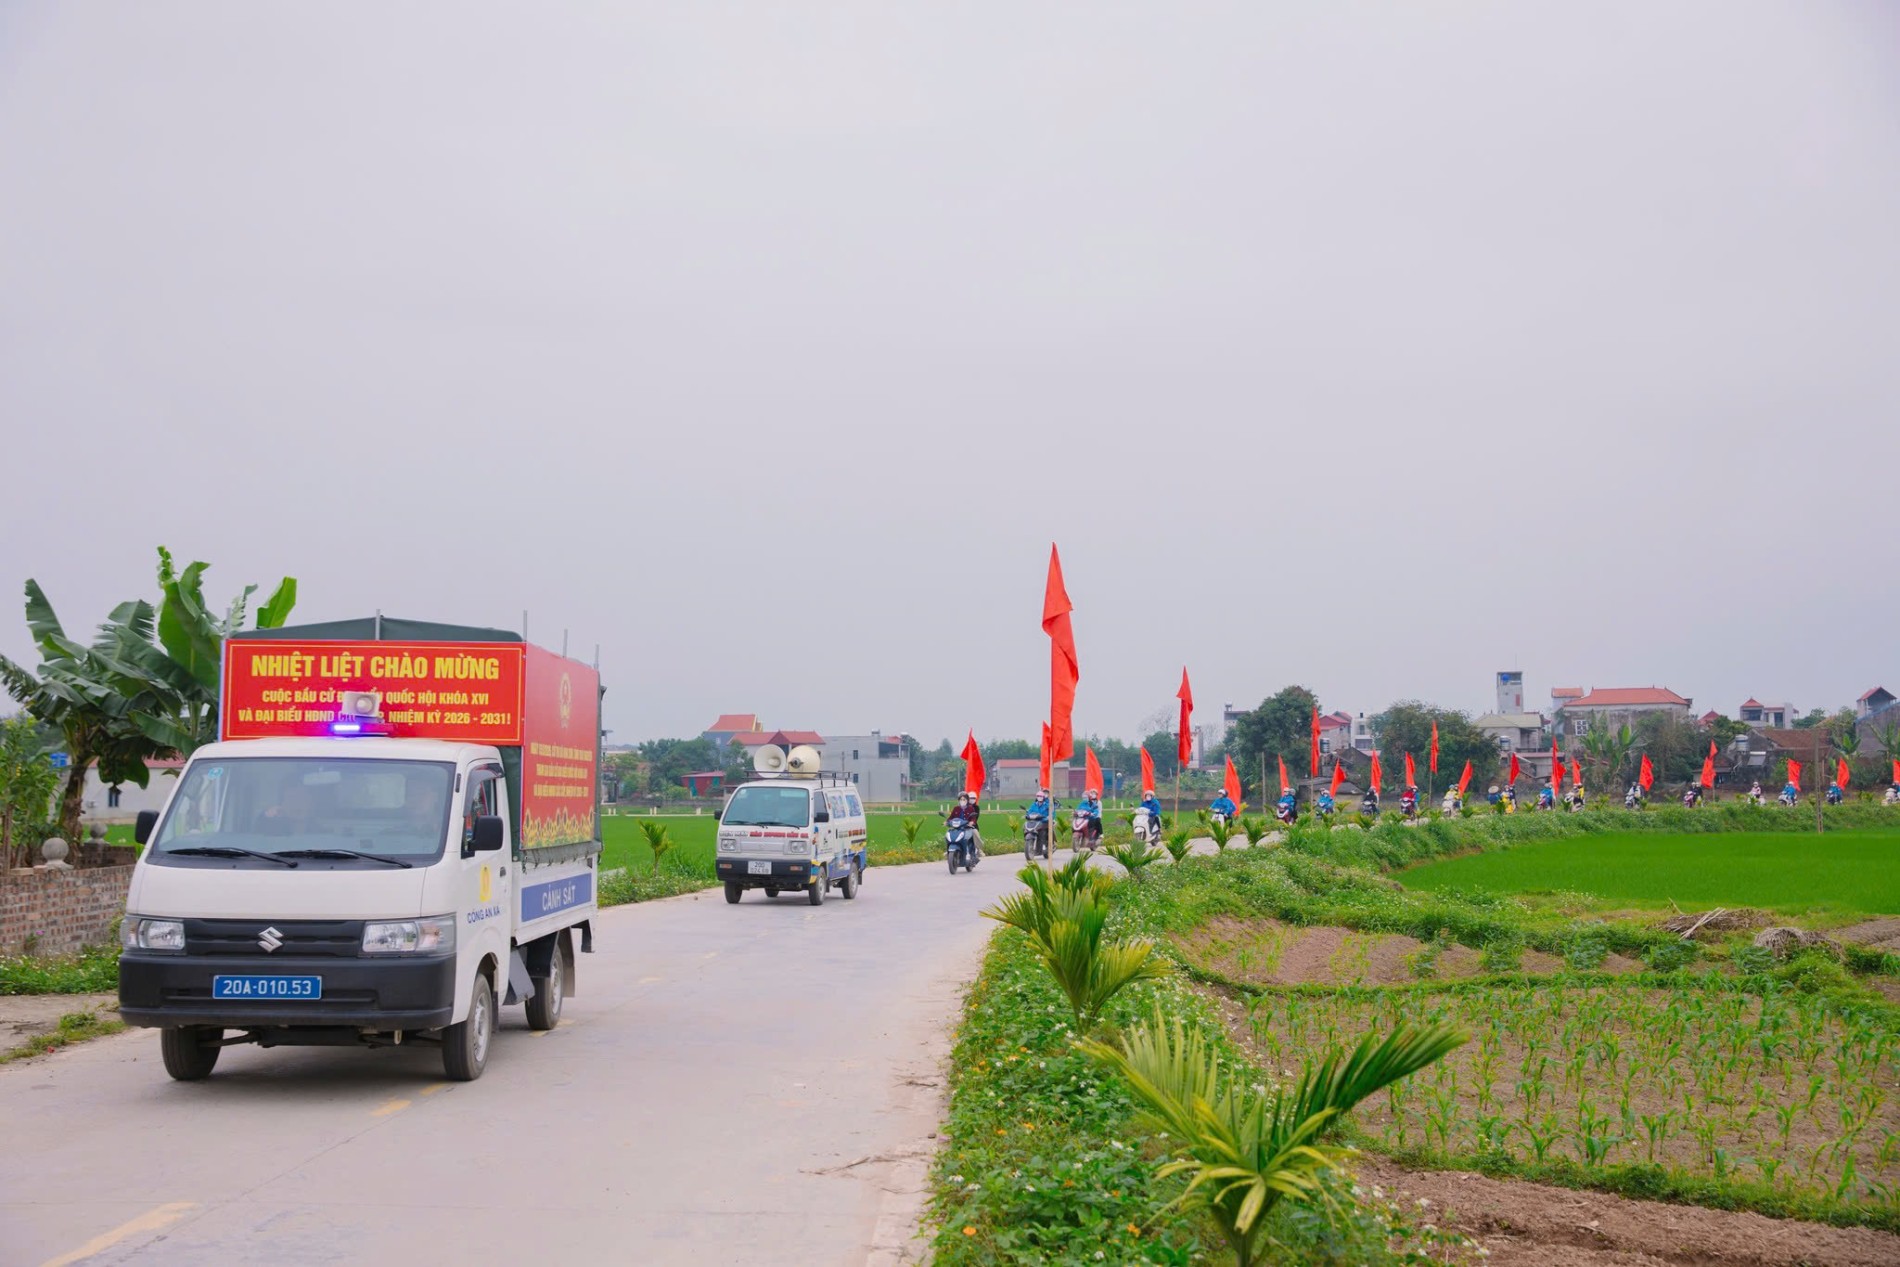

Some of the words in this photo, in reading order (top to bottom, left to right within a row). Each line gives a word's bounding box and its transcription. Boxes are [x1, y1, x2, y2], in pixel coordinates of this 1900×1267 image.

[251, 651, 315, 682] NHIỆT
[320, 651, 365, 682] LIỆT
[370, 652, 428, 678] CHÀO
[434, 653, 500, 680] MỪNG
[262, 688, 292, 705] CUỘC
[319, 687, 336, 703] CỬ
[385, 688, 415, 705] QUỐC
[417, 690, 436, 706] HỘI
[439, 691, 468, 705] KHÓA
[471, 693, 489, 705] XVI
[238, 707, 253, 722] VÀ
[255, 709, 275, 724] ĐẠI
[276, 705, 302, 722] BIỂU
[304, 709, 335, 722] HĐND
[388, 709, 424, 726] NHIỆM
[427, 709, 441, 724] KỲ
[443, 712, 470, 724] 2026
[480, 713, 511, 725] 2031!
[541, 884, 561, 912] CẢNH
[563, 881, 576, 905] SÁT
[222, 980, 312, 995] 20A-010.53
